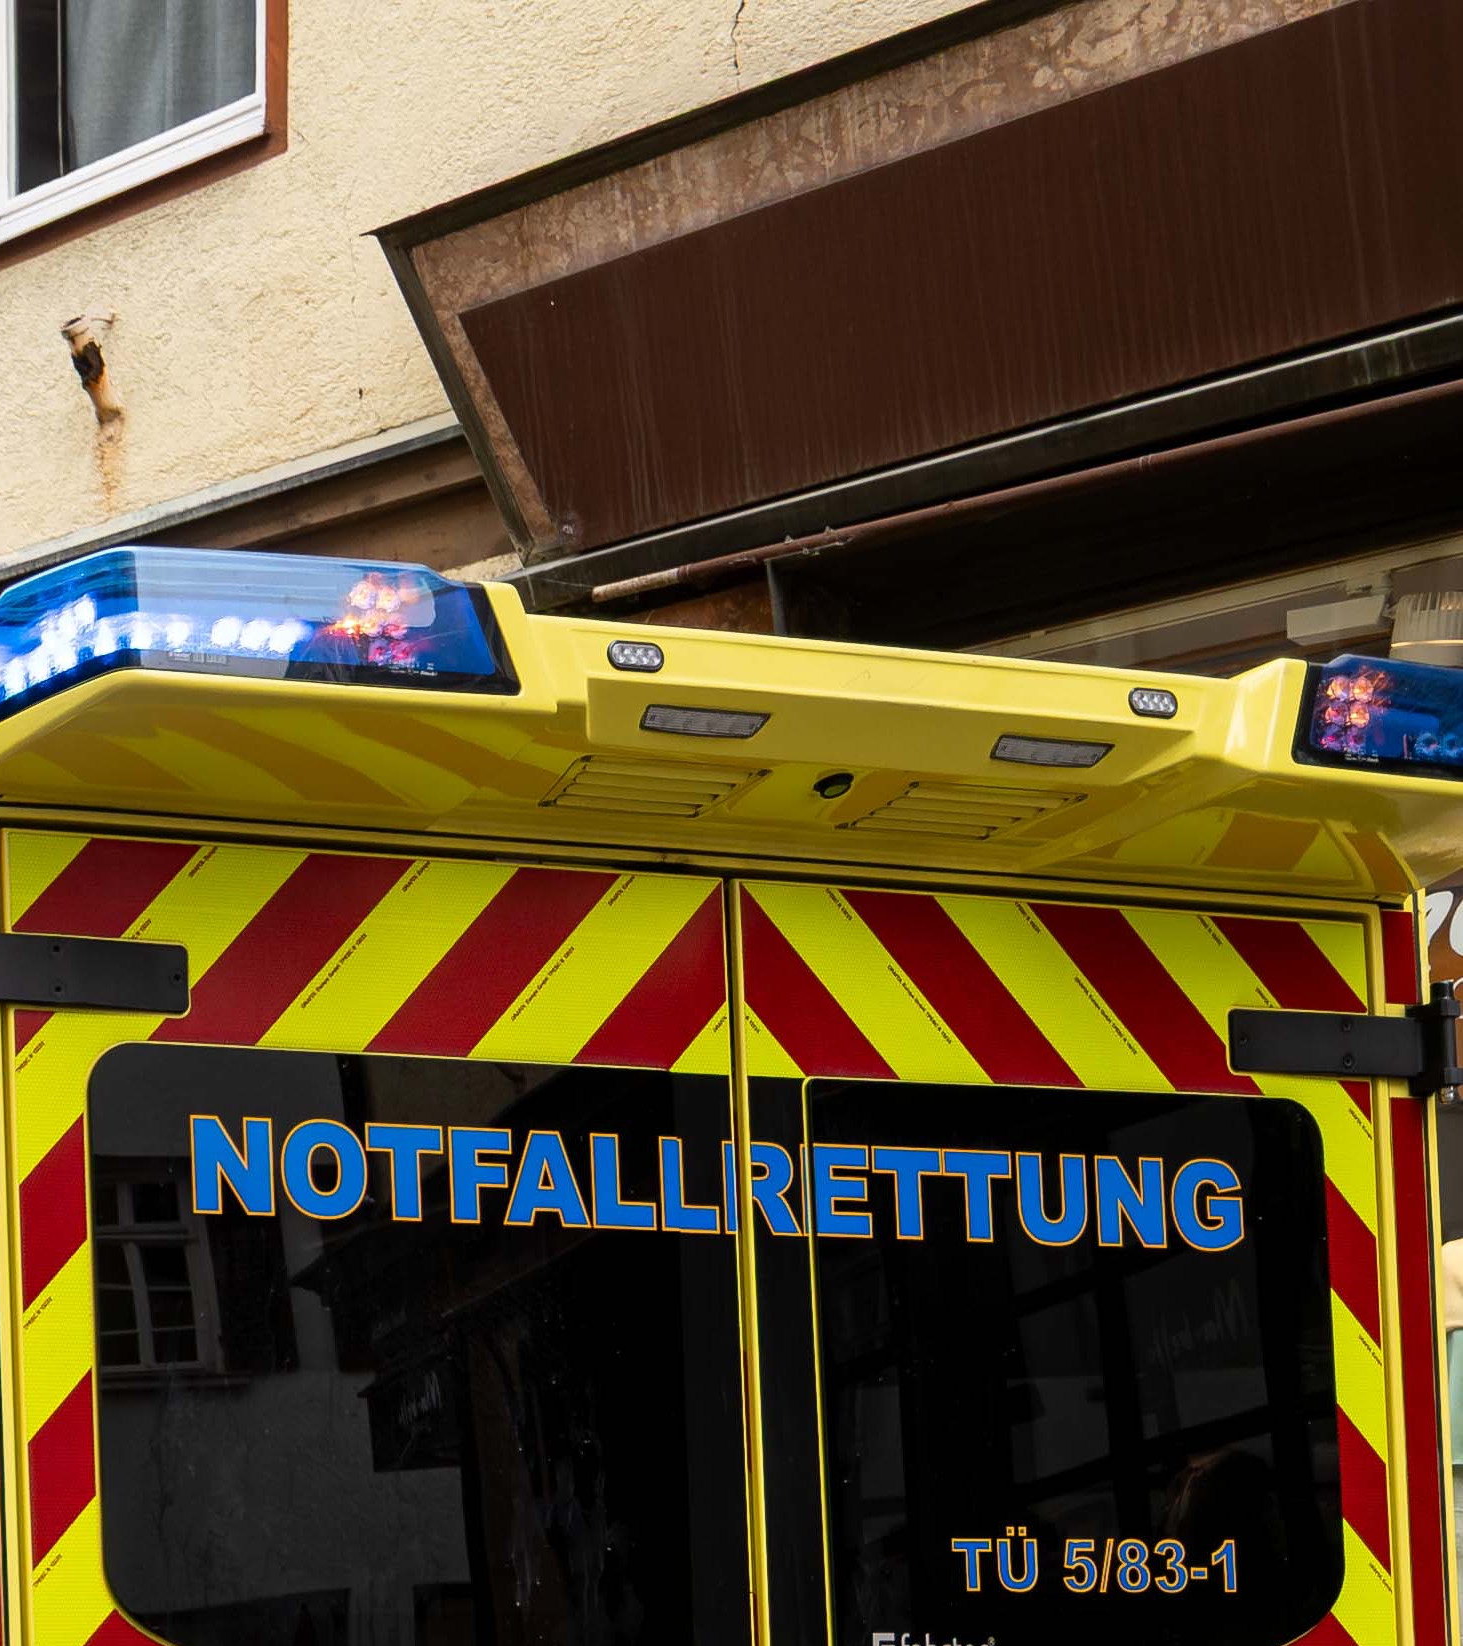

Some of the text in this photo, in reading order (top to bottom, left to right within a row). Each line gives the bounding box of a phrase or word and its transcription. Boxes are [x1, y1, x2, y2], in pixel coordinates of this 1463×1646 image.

[190, 1114, 1245, 1252] NOTFALLRETTUNG
[951, 1526, 1238, 1594] TÜ 5/83-1
